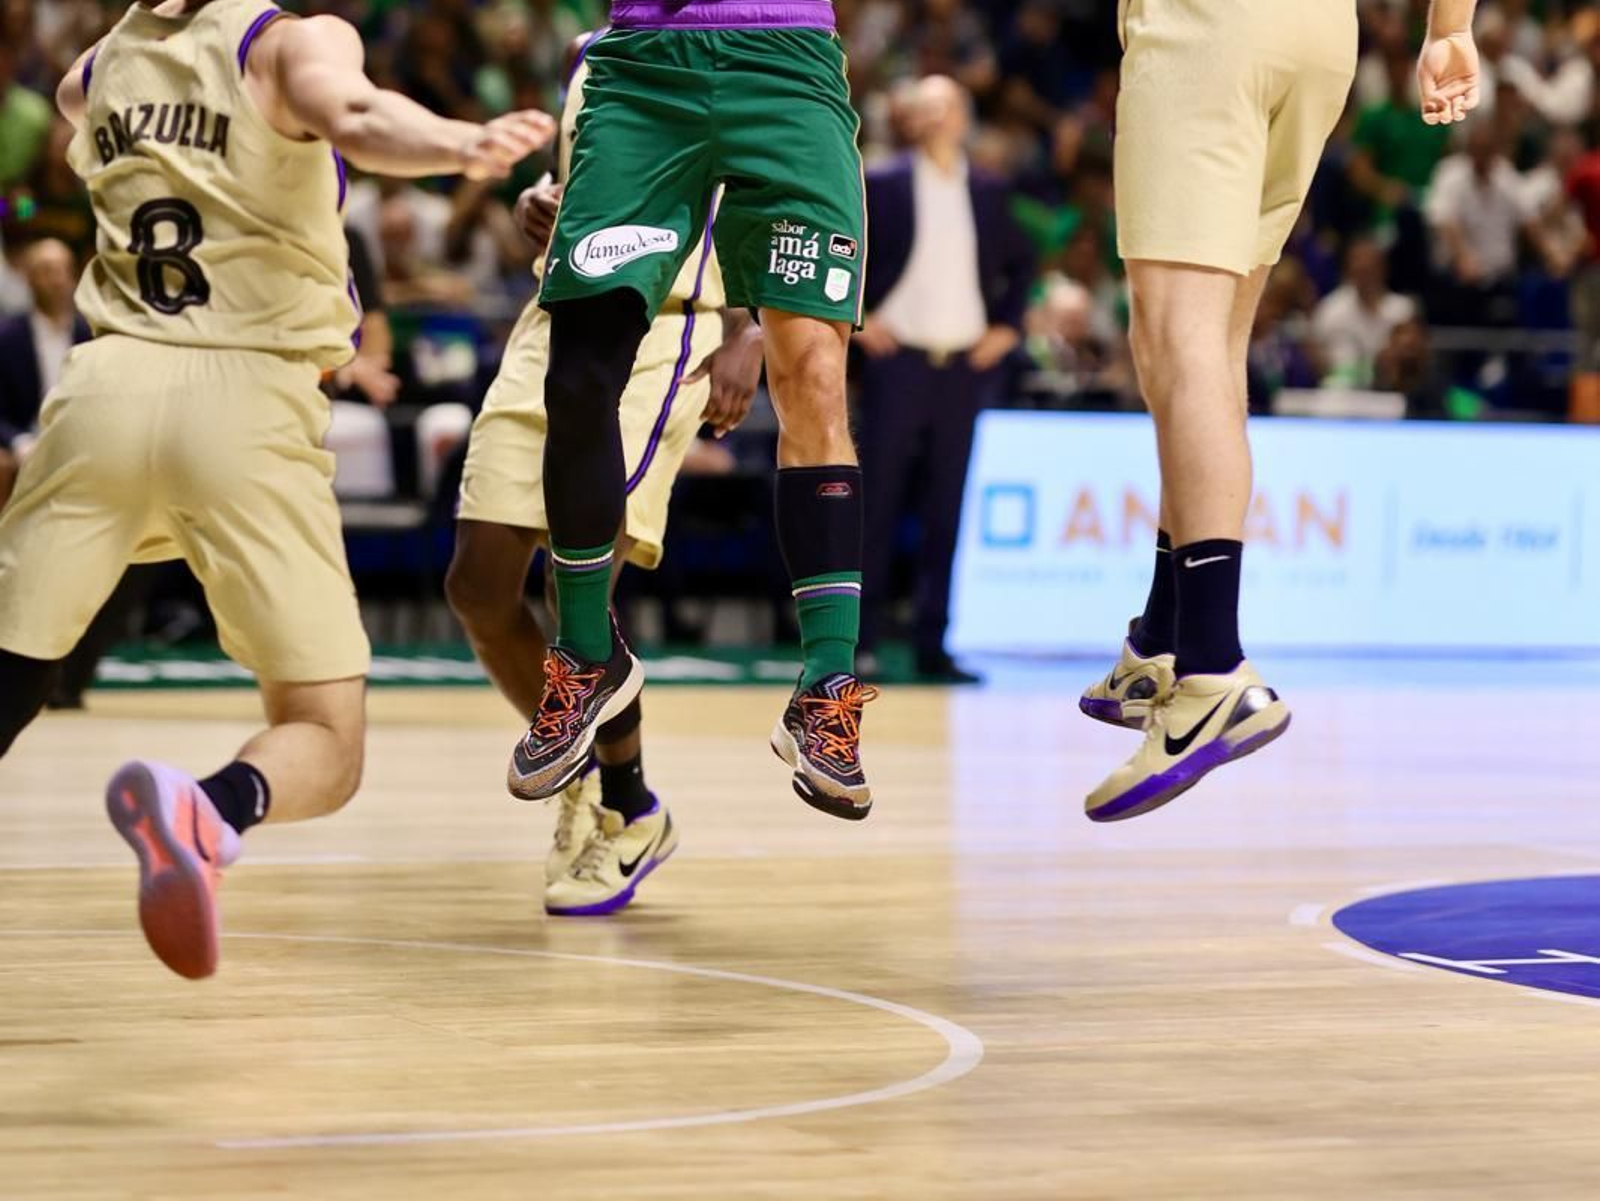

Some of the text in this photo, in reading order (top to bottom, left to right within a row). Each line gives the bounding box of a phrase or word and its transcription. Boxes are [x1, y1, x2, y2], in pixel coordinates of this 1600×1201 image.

[771, 219, 808, 235] sabor
[127, 197, 211, 316] 8
[768, 249, 817, 286] laga
